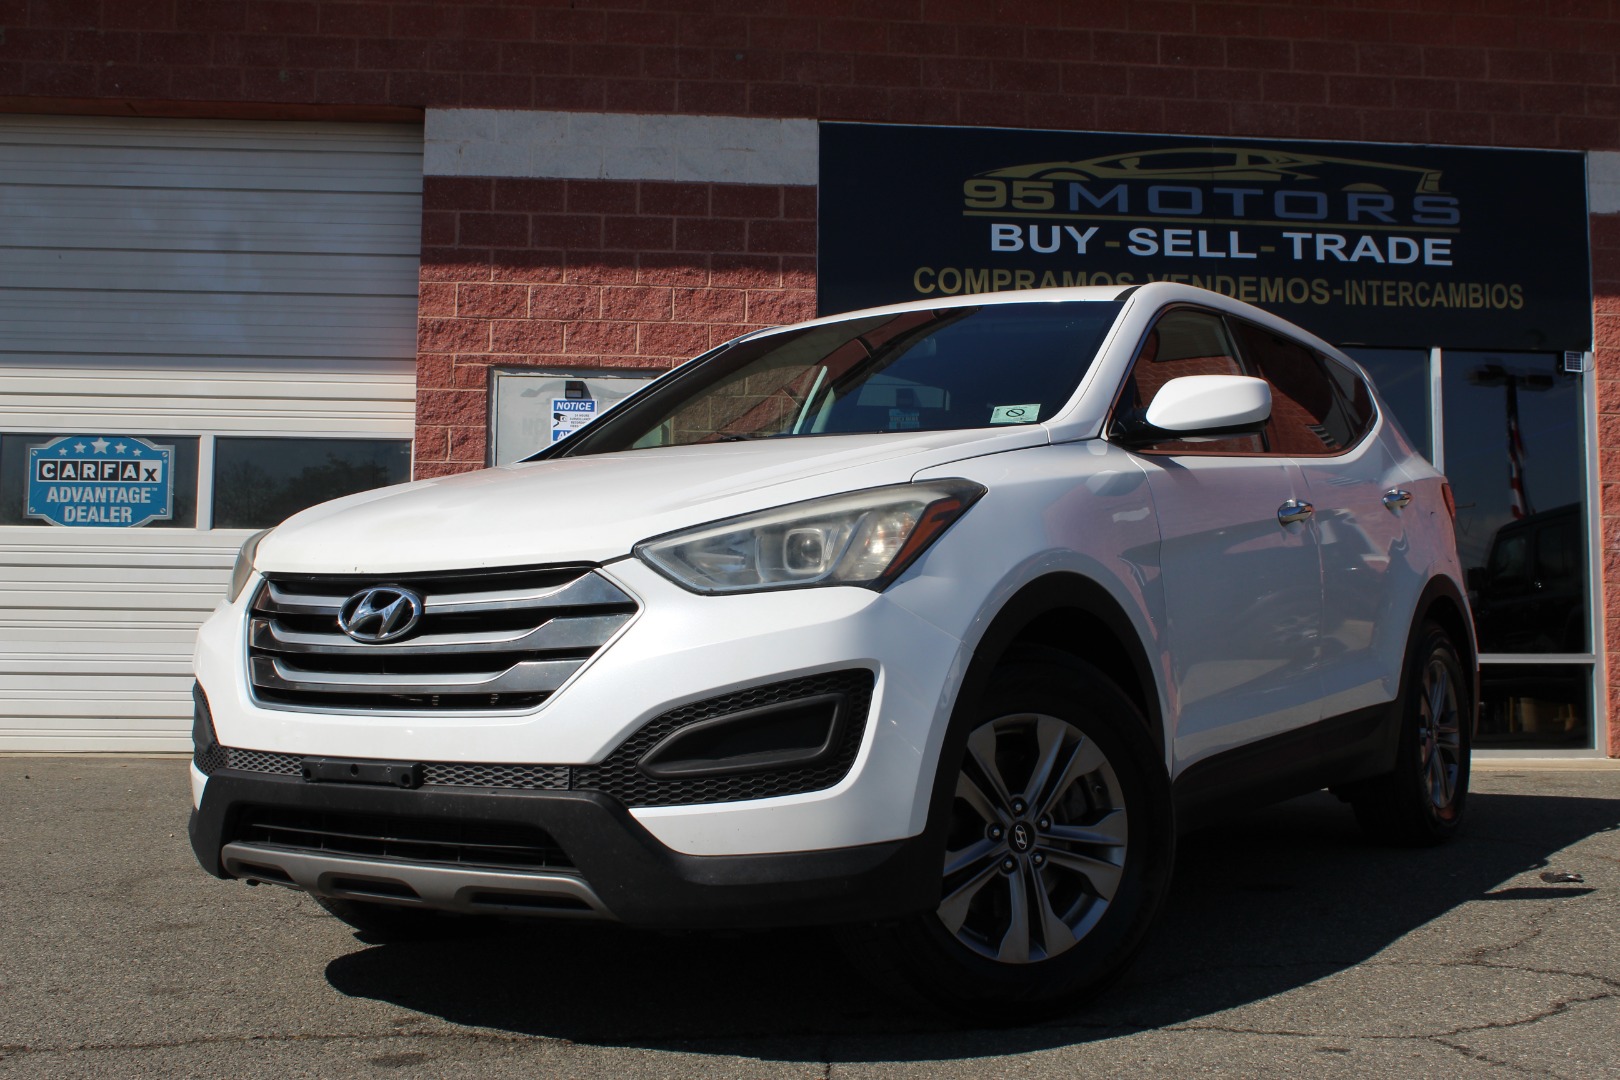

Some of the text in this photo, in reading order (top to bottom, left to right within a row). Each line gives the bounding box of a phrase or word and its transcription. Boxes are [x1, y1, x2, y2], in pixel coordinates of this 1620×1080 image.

[556, 402, 592, 411] NOTICE
[41, 462, 158, 482] CARFAX
[46, 486, 151, 504] ADVANTAGE
[63, 505, 133, 523] DEALER
